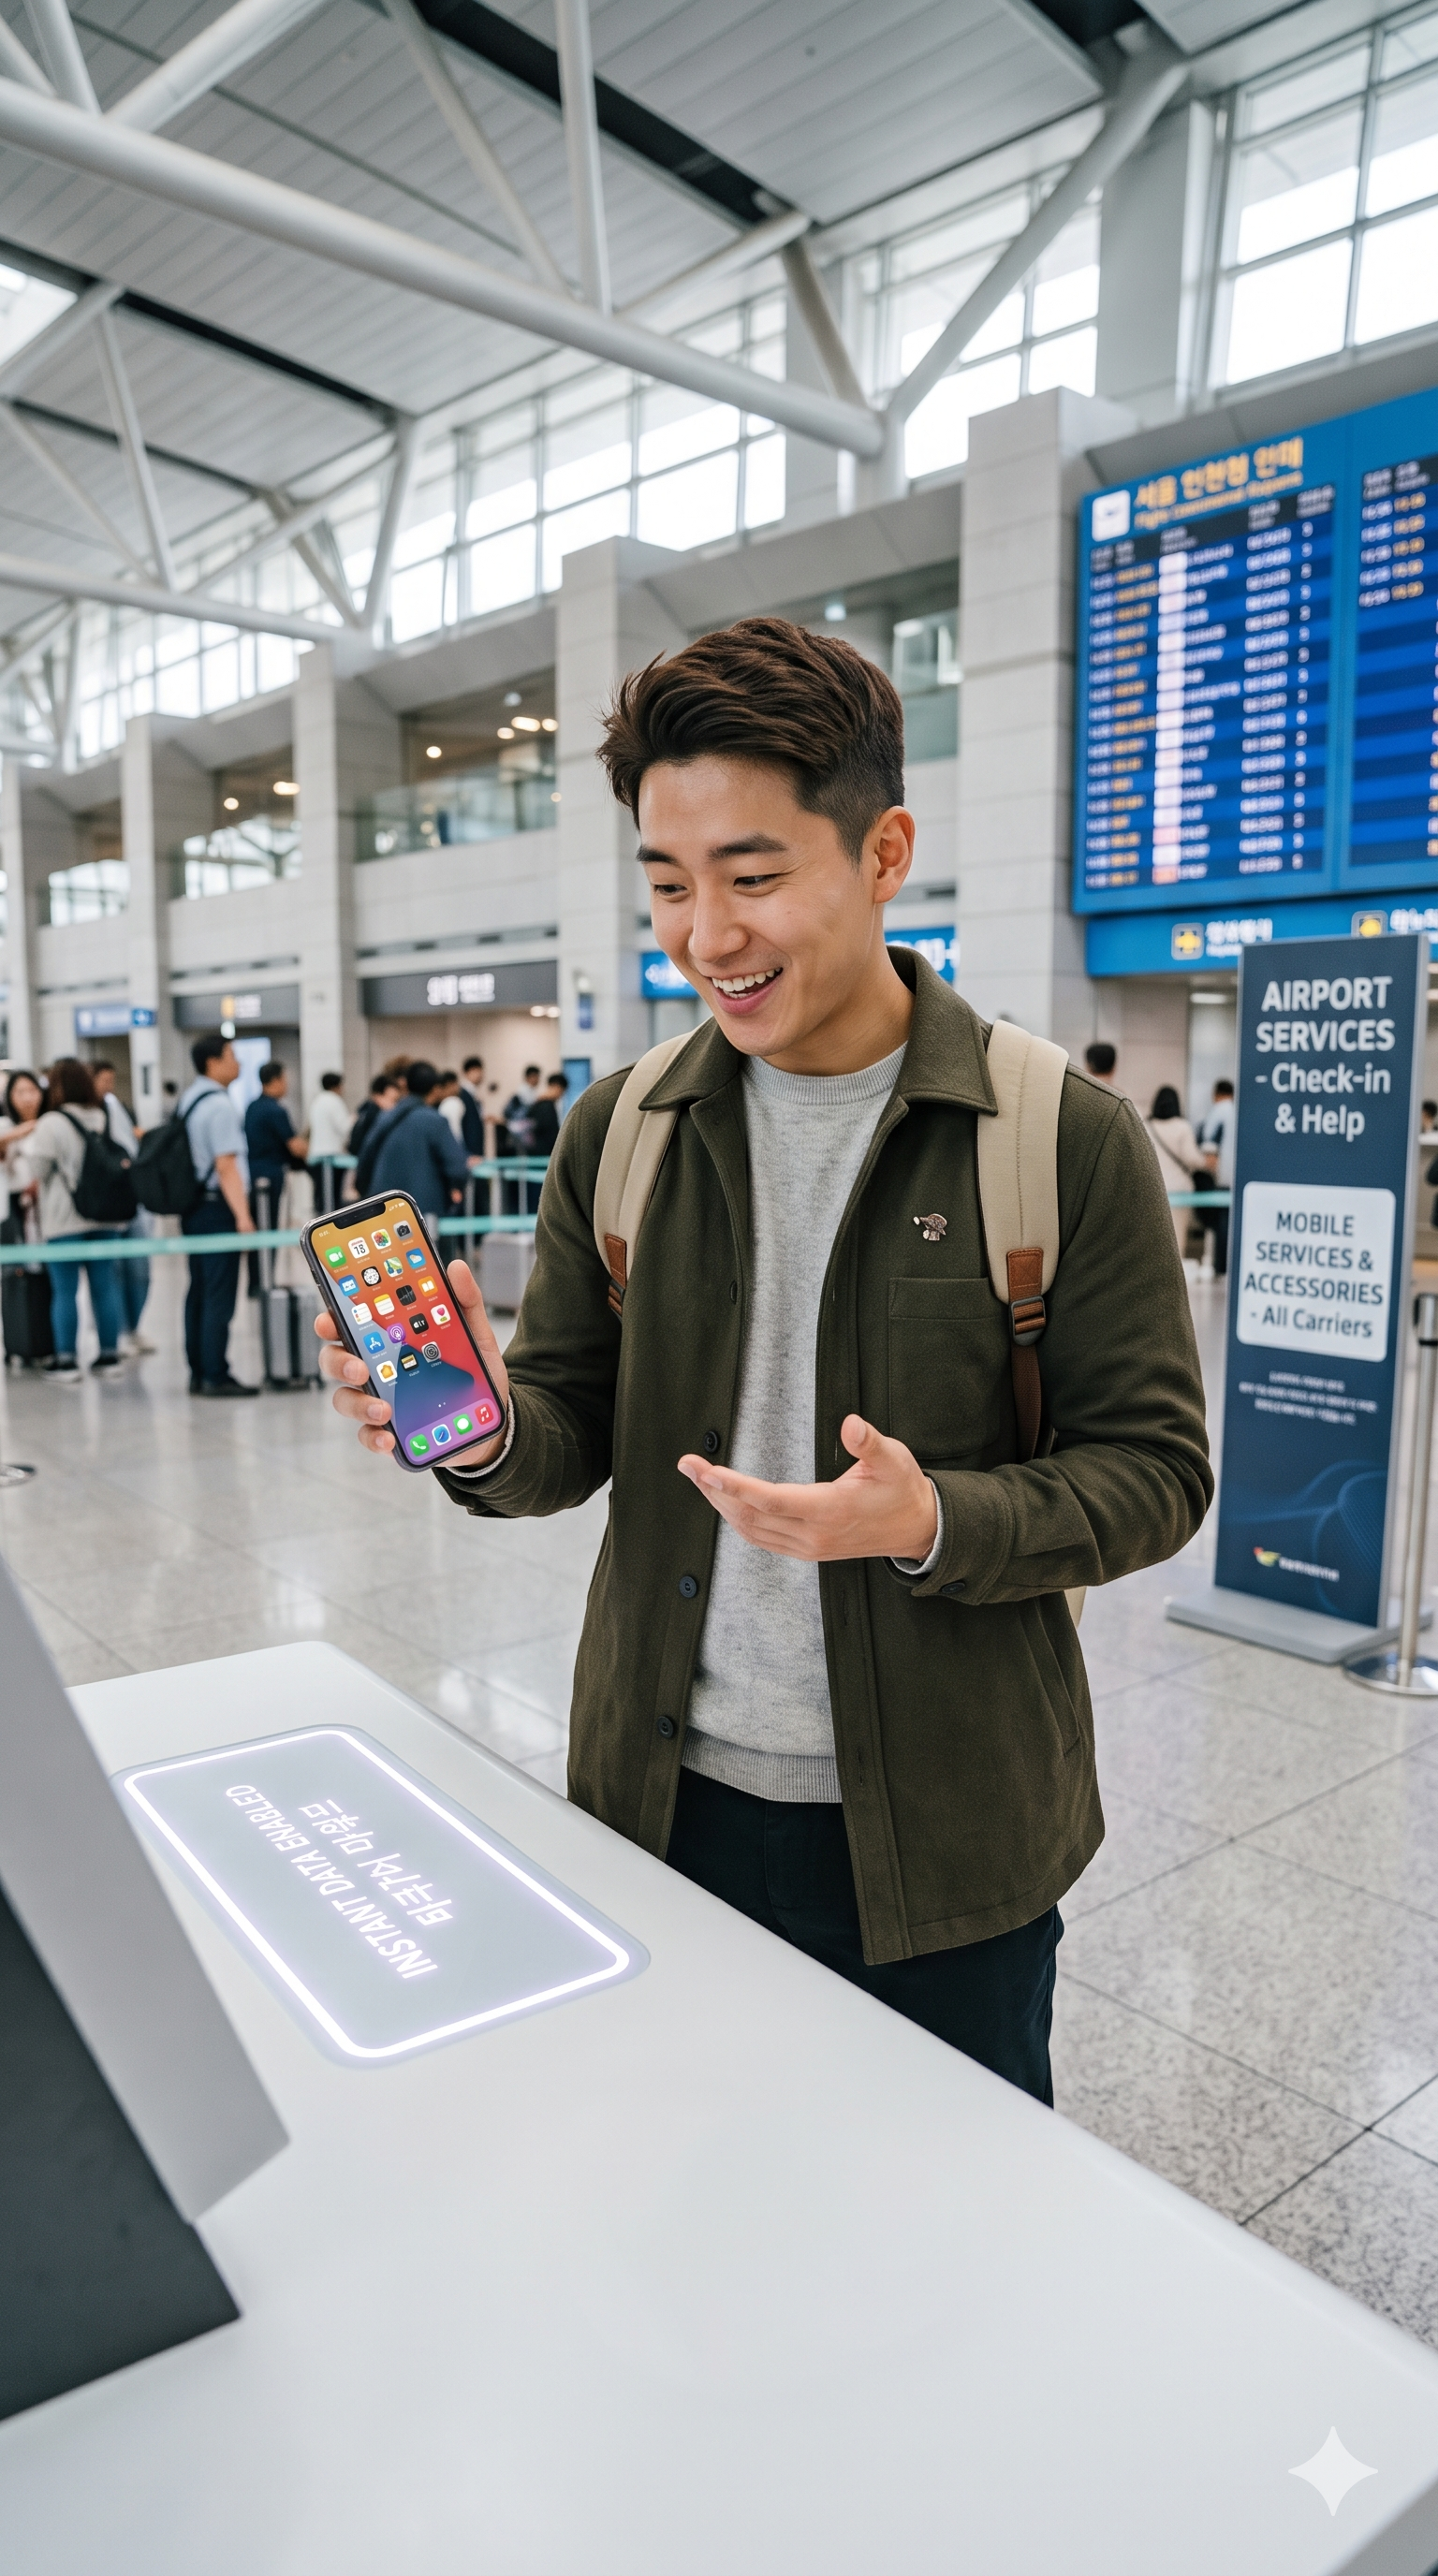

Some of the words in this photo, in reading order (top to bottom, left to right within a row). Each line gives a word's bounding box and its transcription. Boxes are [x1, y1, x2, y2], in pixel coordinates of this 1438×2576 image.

[1261, 975, 1393, 1012] AIRPORT
[1255, 1018, 1396, 1053] SERVICES
[1274, 1103, 1296, 1134] &
[1301, 1104, 1365, 1143] Help
[1276, 1211, 1354, 1237] MOBILE
[1255, 1241, 1353, 1269] SERVICES
[1358, 1250, 1373, 1271] &
[1244, 1273, 1384, 1306] ACCESSORIES
[1262, 1307, 1288, 1327] All
[1292, 1310, 1373, 1339] Carriers
[225, 1784, 311, 1852] ENABLED
[290, 1849, 356, 1897] DATA
[330, 1895, 439, 1981] INSTANT
